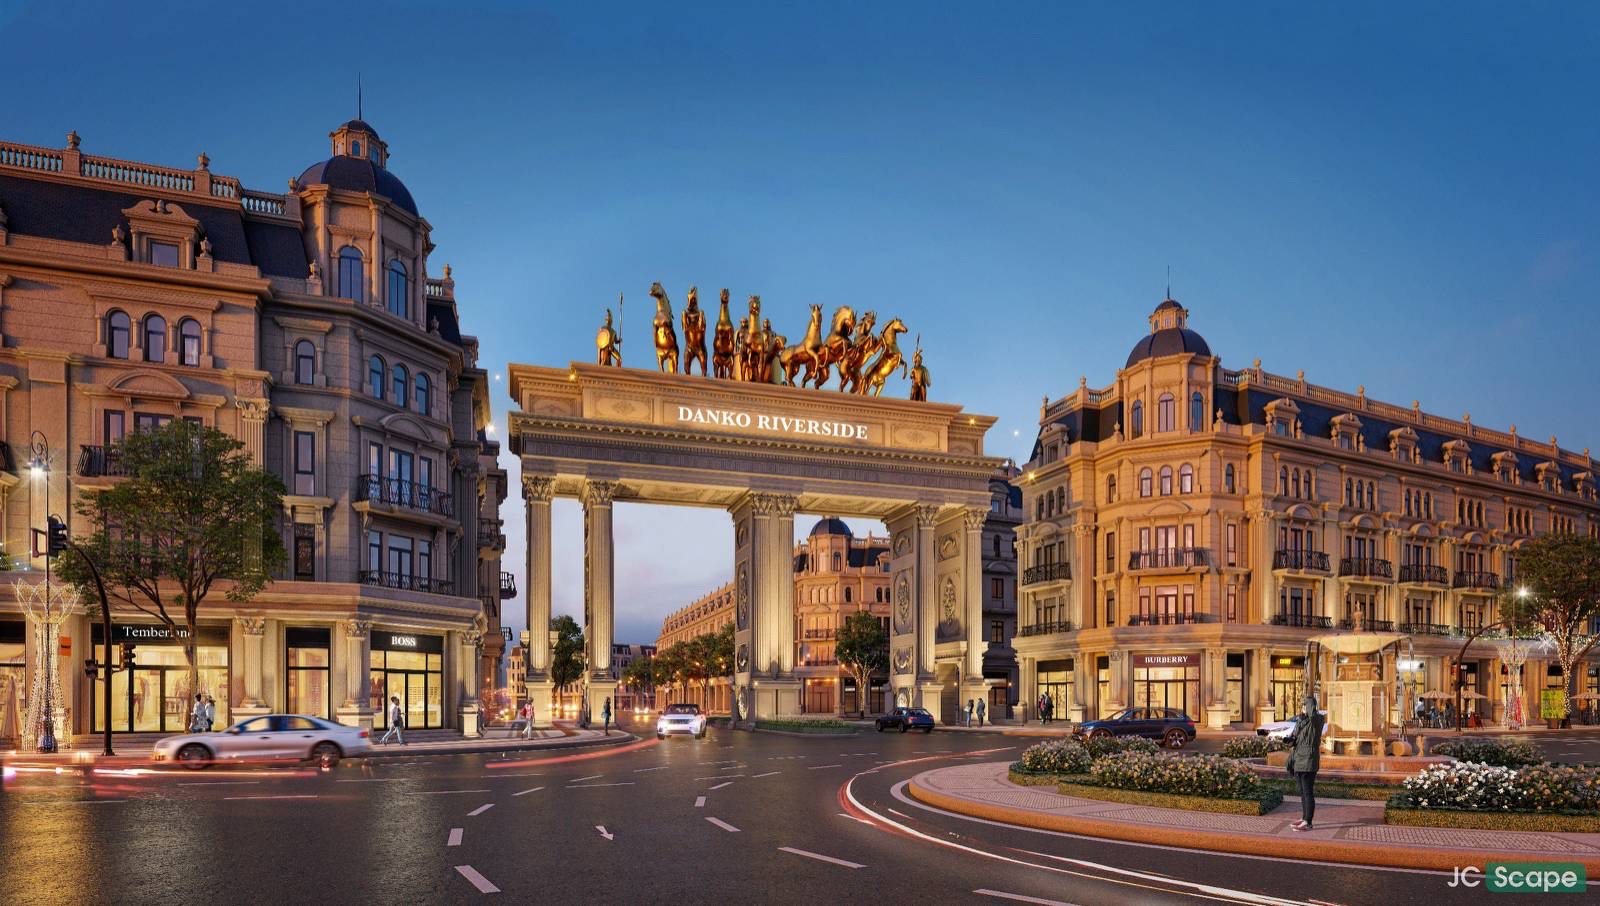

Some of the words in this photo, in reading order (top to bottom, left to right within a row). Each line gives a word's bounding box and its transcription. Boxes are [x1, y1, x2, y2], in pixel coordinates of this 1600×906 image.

[678, 406, 751, 428] DANKO
[757, 415, 868, 440] RIVERSIDE
[391, 636, 416, 646] BOSS
[1145, 655, 1188, 664] BURBERRY
